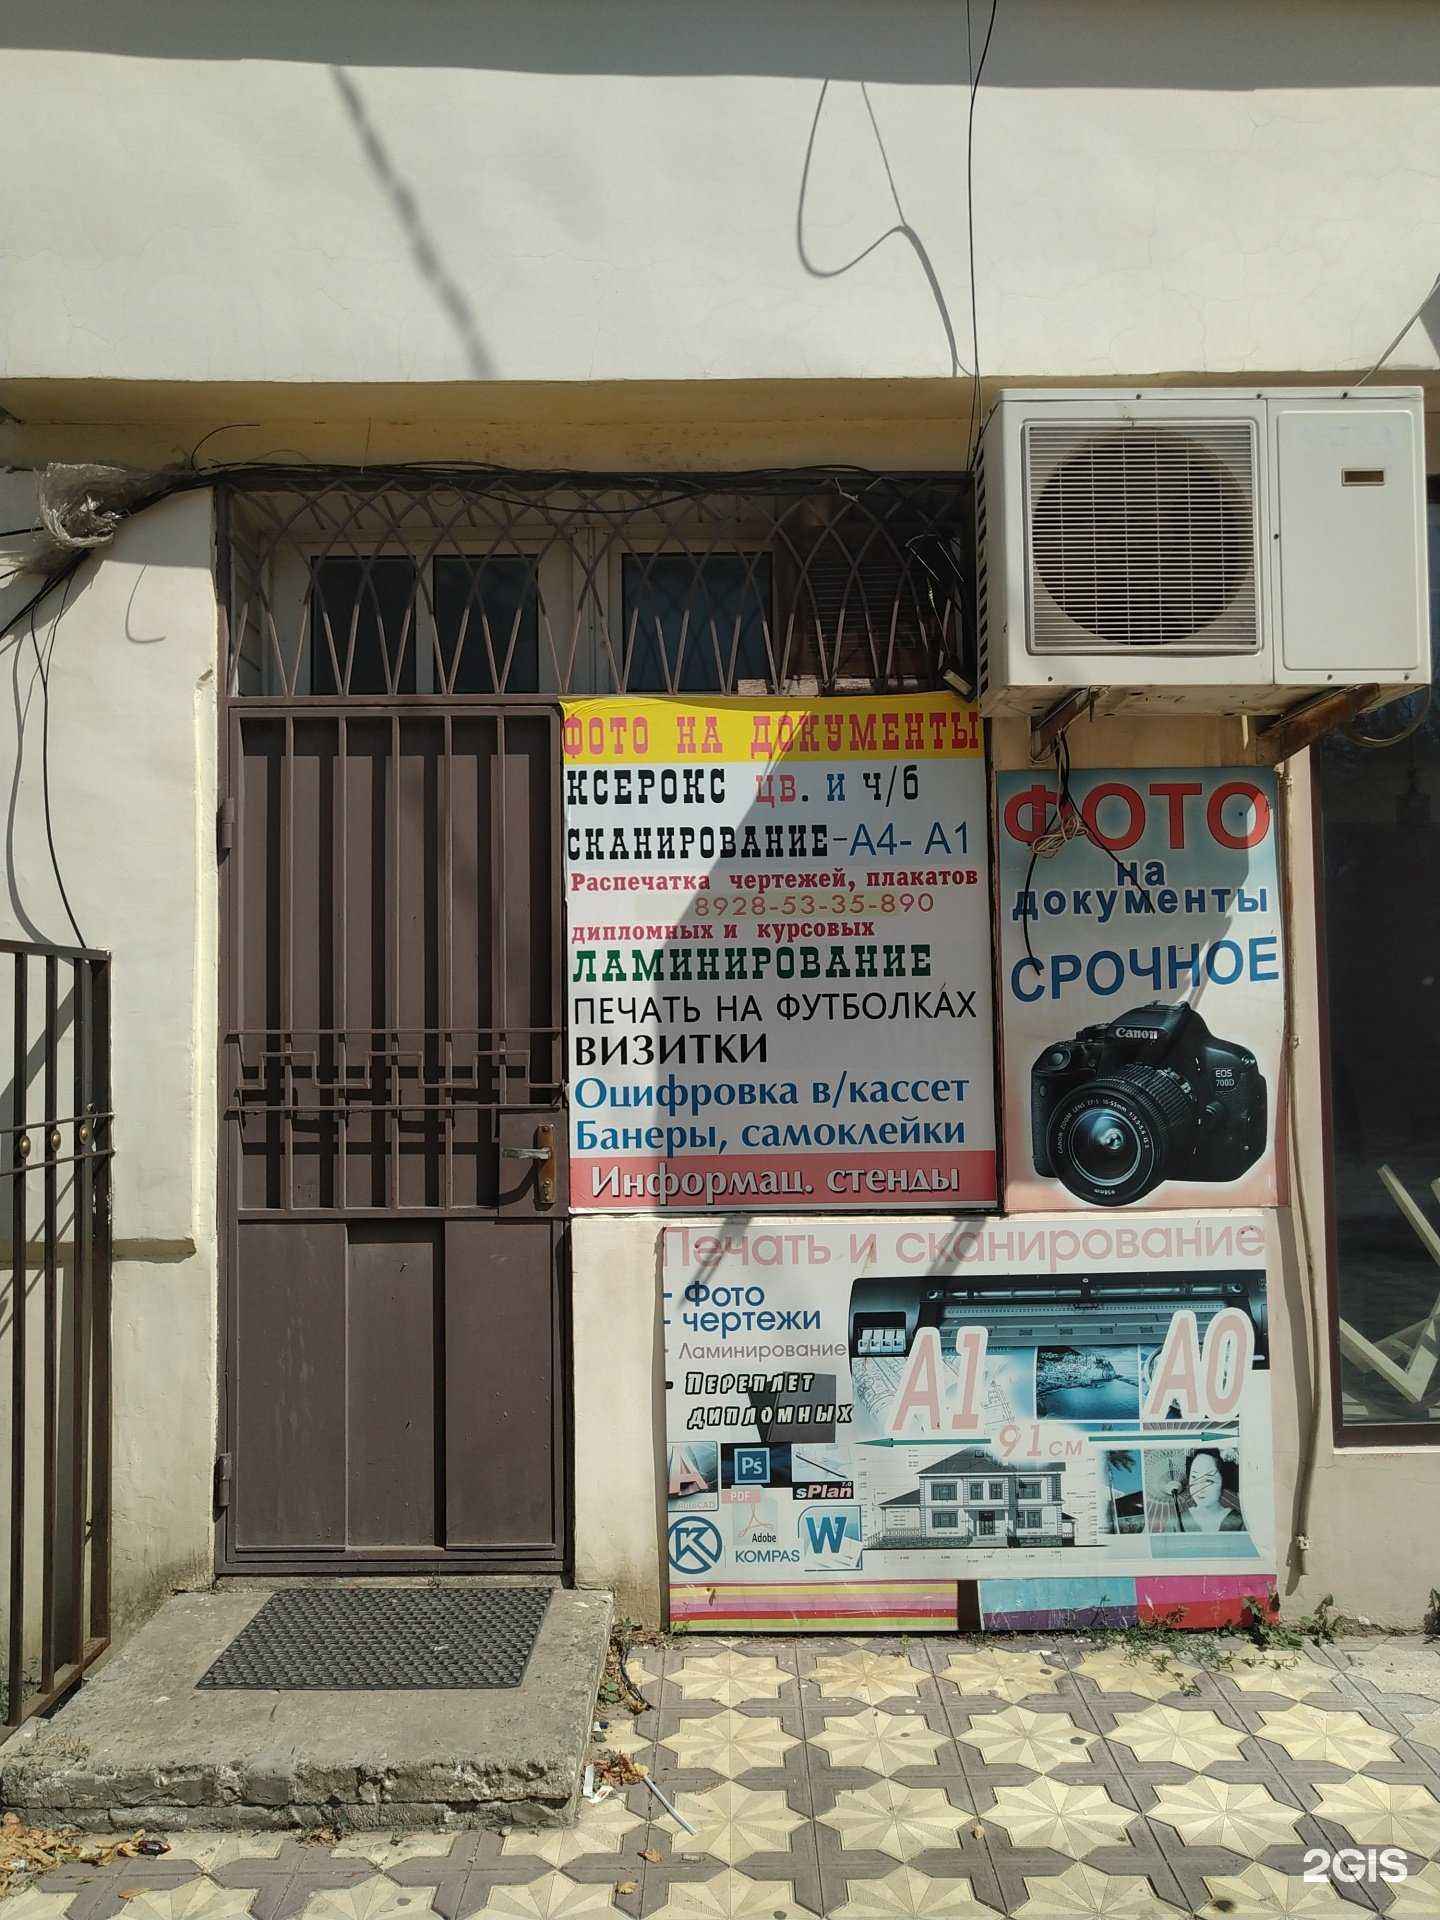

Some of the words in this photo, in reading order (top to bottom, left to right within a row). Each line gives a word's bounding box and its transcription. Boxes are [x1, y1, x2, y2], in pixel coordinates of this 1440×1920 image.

[564, 715, 648, 758] ФОТО
[677, 716, 724, 754] НА
[750, 711, 980, 758] ДОКУМЕНТЫ
[567, 768, 726, 805] КСЕРОКС
[1004, 782, 1271, 850] ФОТО
[571, 872, 711, 892] Распечатка
[729, 868, 856, 898] чертежей,
[866, 869, 978, 889] плакатов
[1116, 861, 1165, 886] на
[695, 892, 935, 917] 8928-53-35-890
[1012, 886, 1267, 923] документы
[571, 923, 713, 945] дипломных
[723, 923, 738, 939] и
[757, 919, 875, 943] курсовых
[572, 943, 931, 983] ЛАМИНИРОВАНИЕ
[1010, 935, 1280, 1003] СРОЧНОЕ
[574, 996, 701, 1025] ПЕЧАТЬ
[717, 995, 763, 1023] НА
[776, 988, 977, 1021] ФУТБОЛКАХ
[575, 1032, 768, 1066] ВИЗИТКИ
[1115, 1027, 1158, 1040] Canon
[1215, 1069, 1233, 1078] EOS
[574, 1073, 799, 1117] Оцифровка
[813, 1070, 970, 1109] в/кассет
[576, 1120, 729, 1158] Банеры,
[741, 1115, 965, 1148] самоклейки
[591, 1161, 815, 1206] Информац.
[826, 1167, 960, 1194] стенды
[664, 1227, 832, 1267] Печать
[850, 1231, 878, 1265] и
[896, 1225, 1266, 1273] сканирование
[684, 1280, 765, 1308] Фото
[683, 1310, 821, 1339] чертежи
[678, 1342, 847, 1363] Ламинирование
[999, 1423, 1043, 1458] 91
[742, 1457, 763, 1475] Ps
[730, 1491, 751, 1501] PDF
[796, 1484, 852, 1499] sPlan
[752, 1533, 777, 1543] Adobe
[805, 1516, 847, 1554] W
[735, 1550, 800, 1563] KOMPAS
